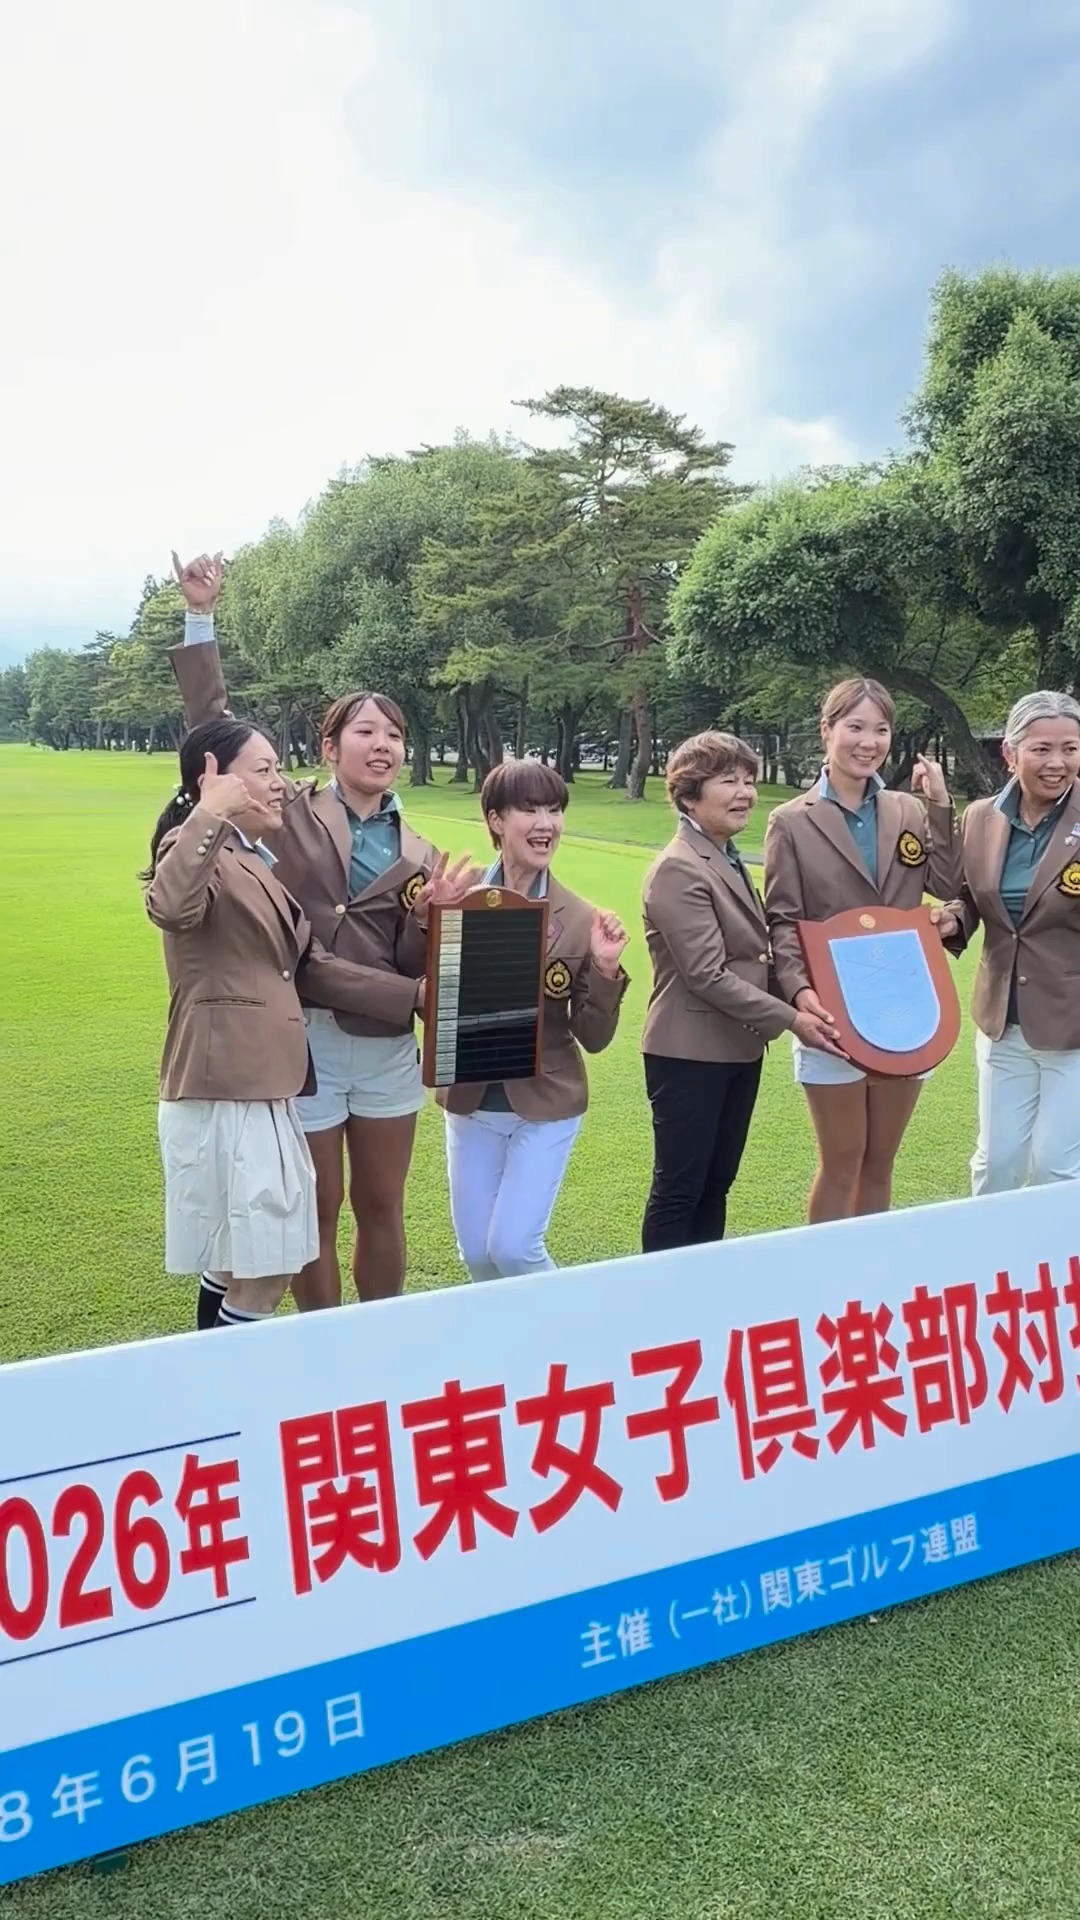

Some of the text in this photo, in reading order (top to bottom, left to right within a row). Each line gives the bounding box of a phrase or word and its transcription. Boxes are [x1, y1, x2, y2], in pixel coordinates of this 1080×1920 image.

[280, 1256, 1080, 1595] 関東女子倶楽部対
